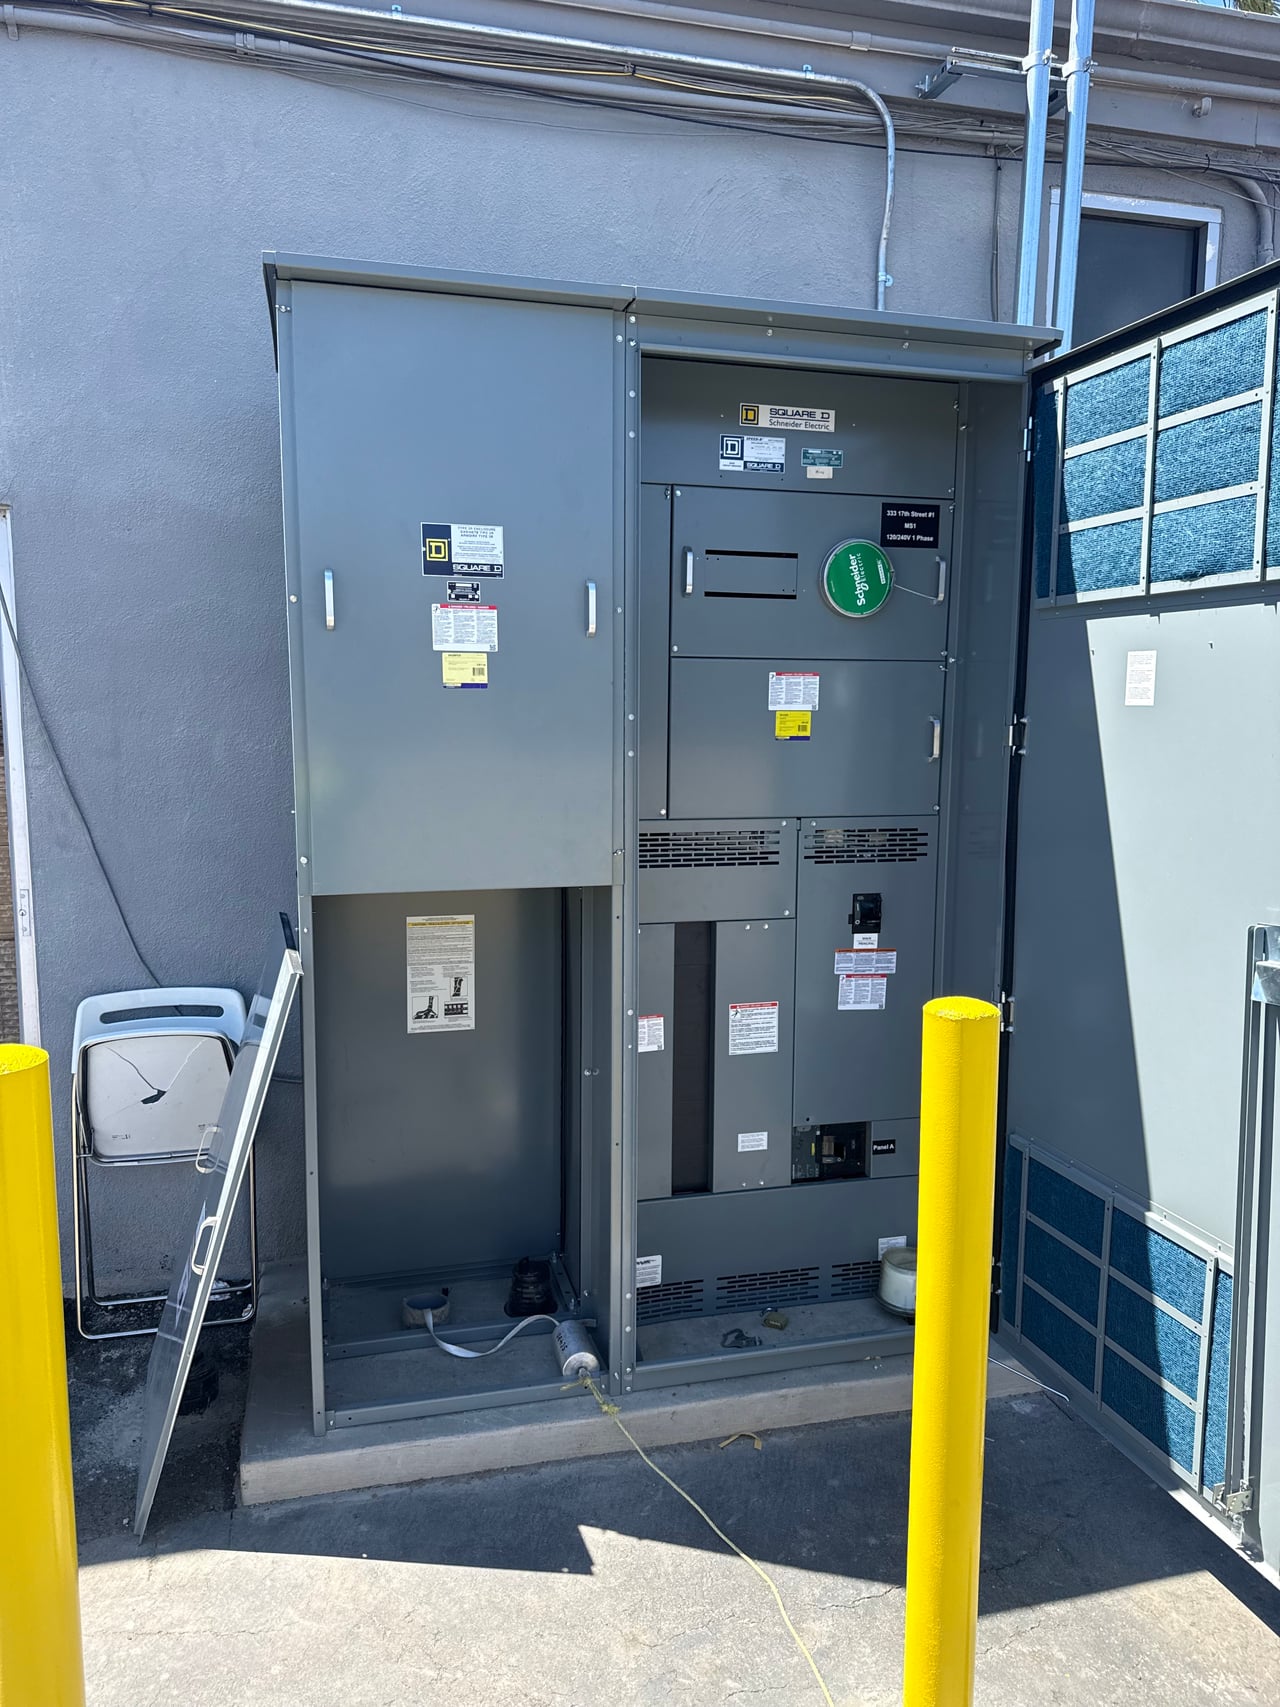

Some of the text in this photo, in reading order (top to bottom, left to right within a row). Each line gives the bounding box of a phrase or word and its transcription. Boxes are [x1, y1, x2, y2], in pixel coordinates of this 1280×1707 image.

[769, 408, 831, 420] SQUARE D
[768, 418, 830, 431] Schneider Electric
[452, 563, 491, 572] SQUARE
[849, 554, 866, 606] Schneider
[873, 1143, 889, 1151] Panel
